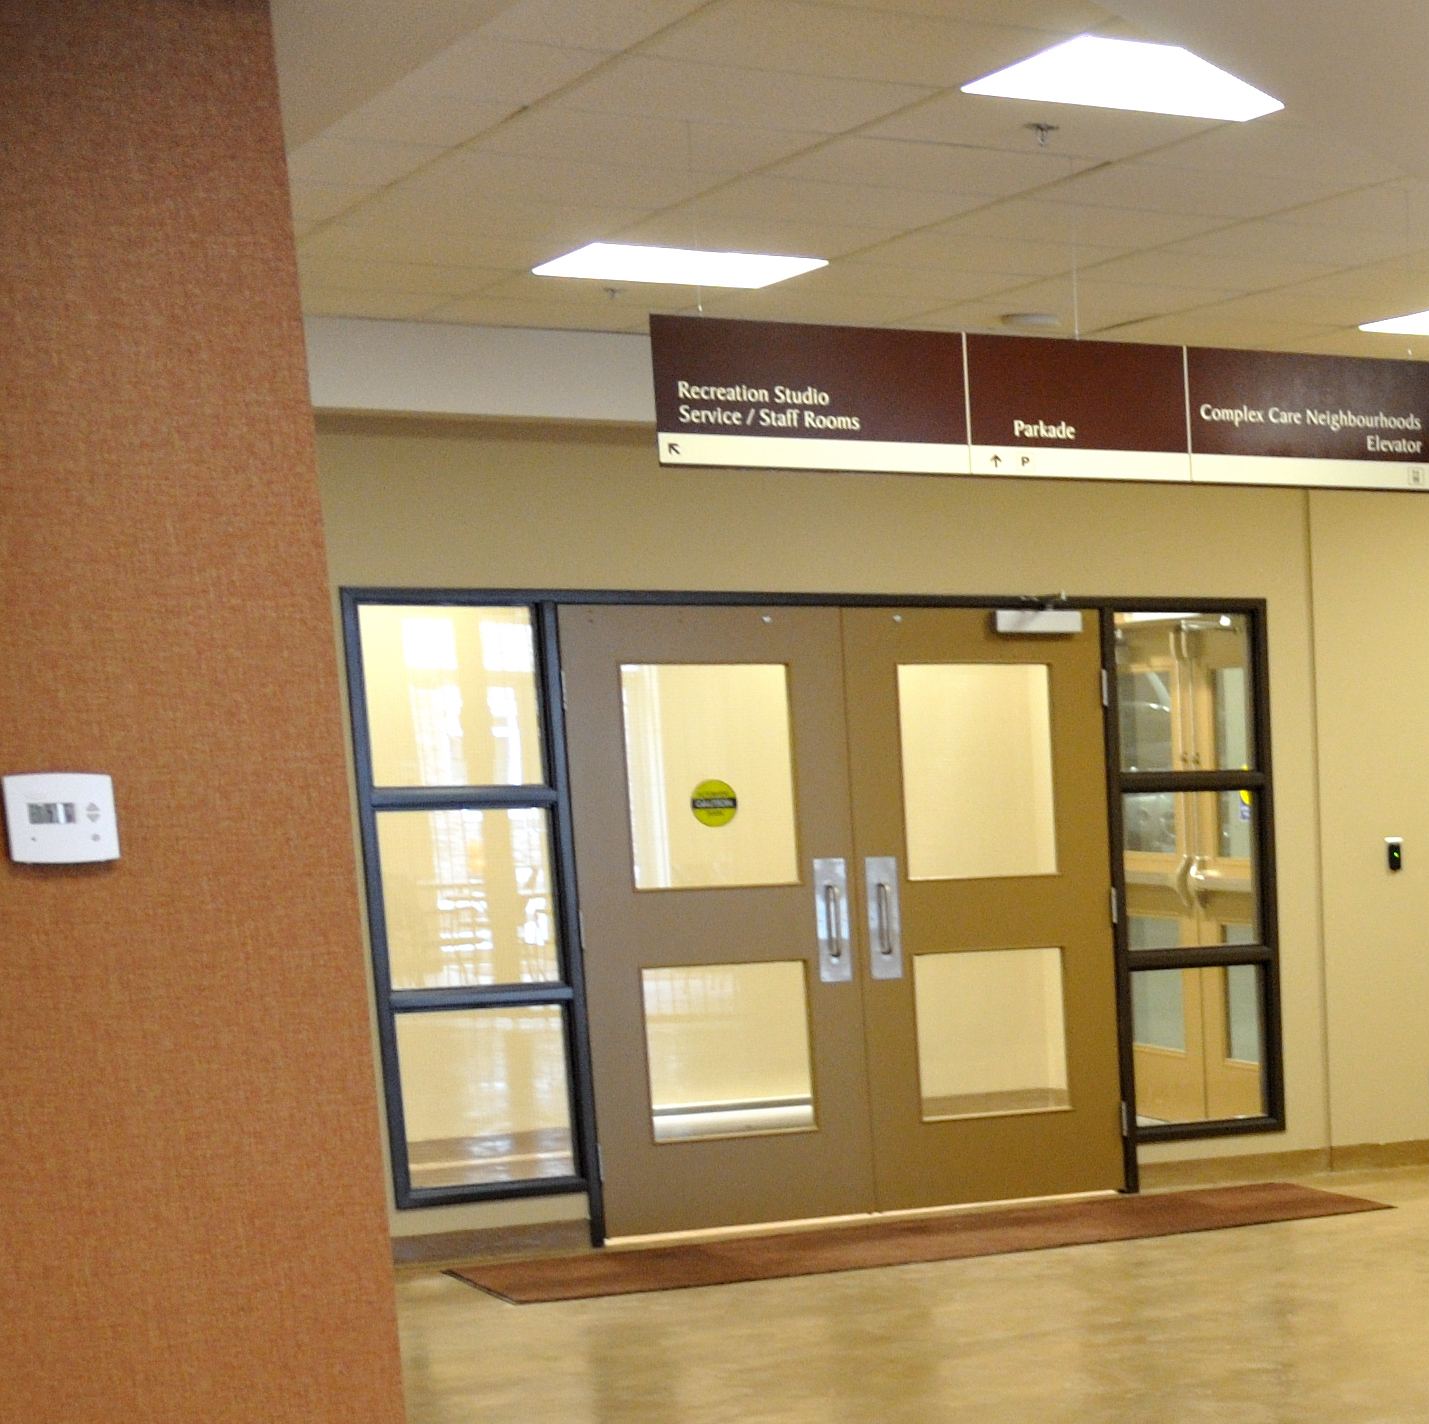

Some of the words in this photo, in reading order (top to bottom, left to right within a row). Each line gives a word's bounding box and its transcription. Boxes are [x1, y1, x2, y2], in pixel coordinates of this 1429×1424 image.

[677, 381, 769, 402] Recreation
[774, 386, 830, 406] Studio
[678, 404, 742, 424] Service
[746, 408, 755, 425] /
[759, 408, 800, 428] Staff
[804, 410, 861, 430] Rooms
[1200, 403, 1264, 427] Complex
[1268, 407, 1301, 424] Care
[1306, 409, 1422, 432] Neighbourhoods
[1013, 419, 1076, 439] Parkade
[1366, 435, 1422, 453] Elevator
[1021, 456, 1030, 467] P
